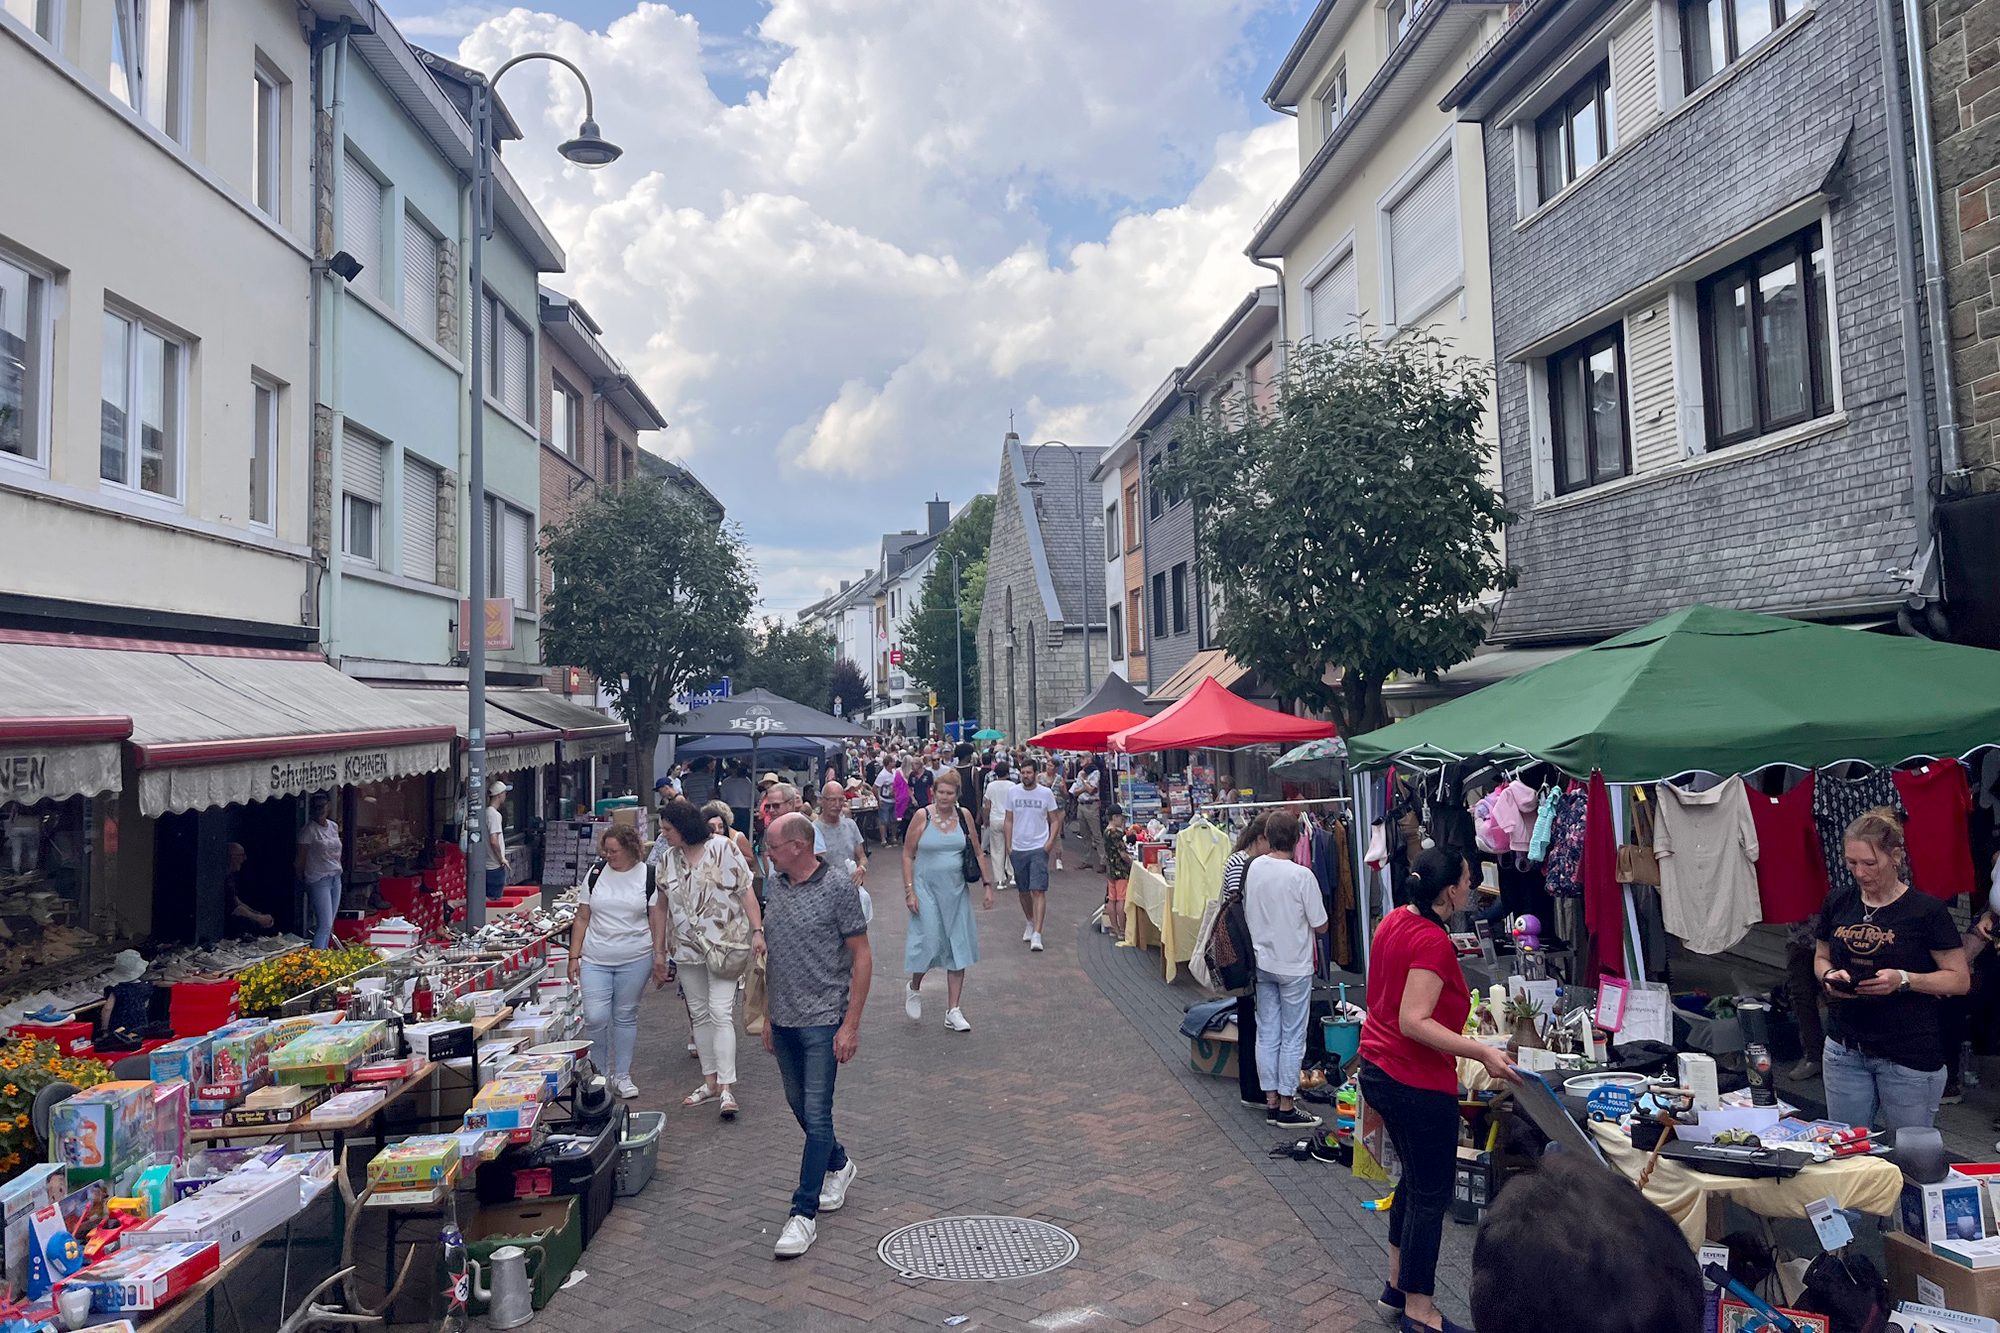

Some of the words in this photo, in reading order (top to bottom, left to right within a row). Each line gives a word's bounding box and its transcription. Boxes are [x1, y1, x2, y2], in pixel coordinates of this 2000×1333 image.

[729, 716, 788, 731] Leffe
[270, 760, 337, 790] Schuhhaus
[343, 753, 388, 779] KOHNEN
[1834, 925, 1865, 939] Hard
[1865, 927, 1895, 945] Rock
[1608, 1099, 1629, 1107] POLICE
